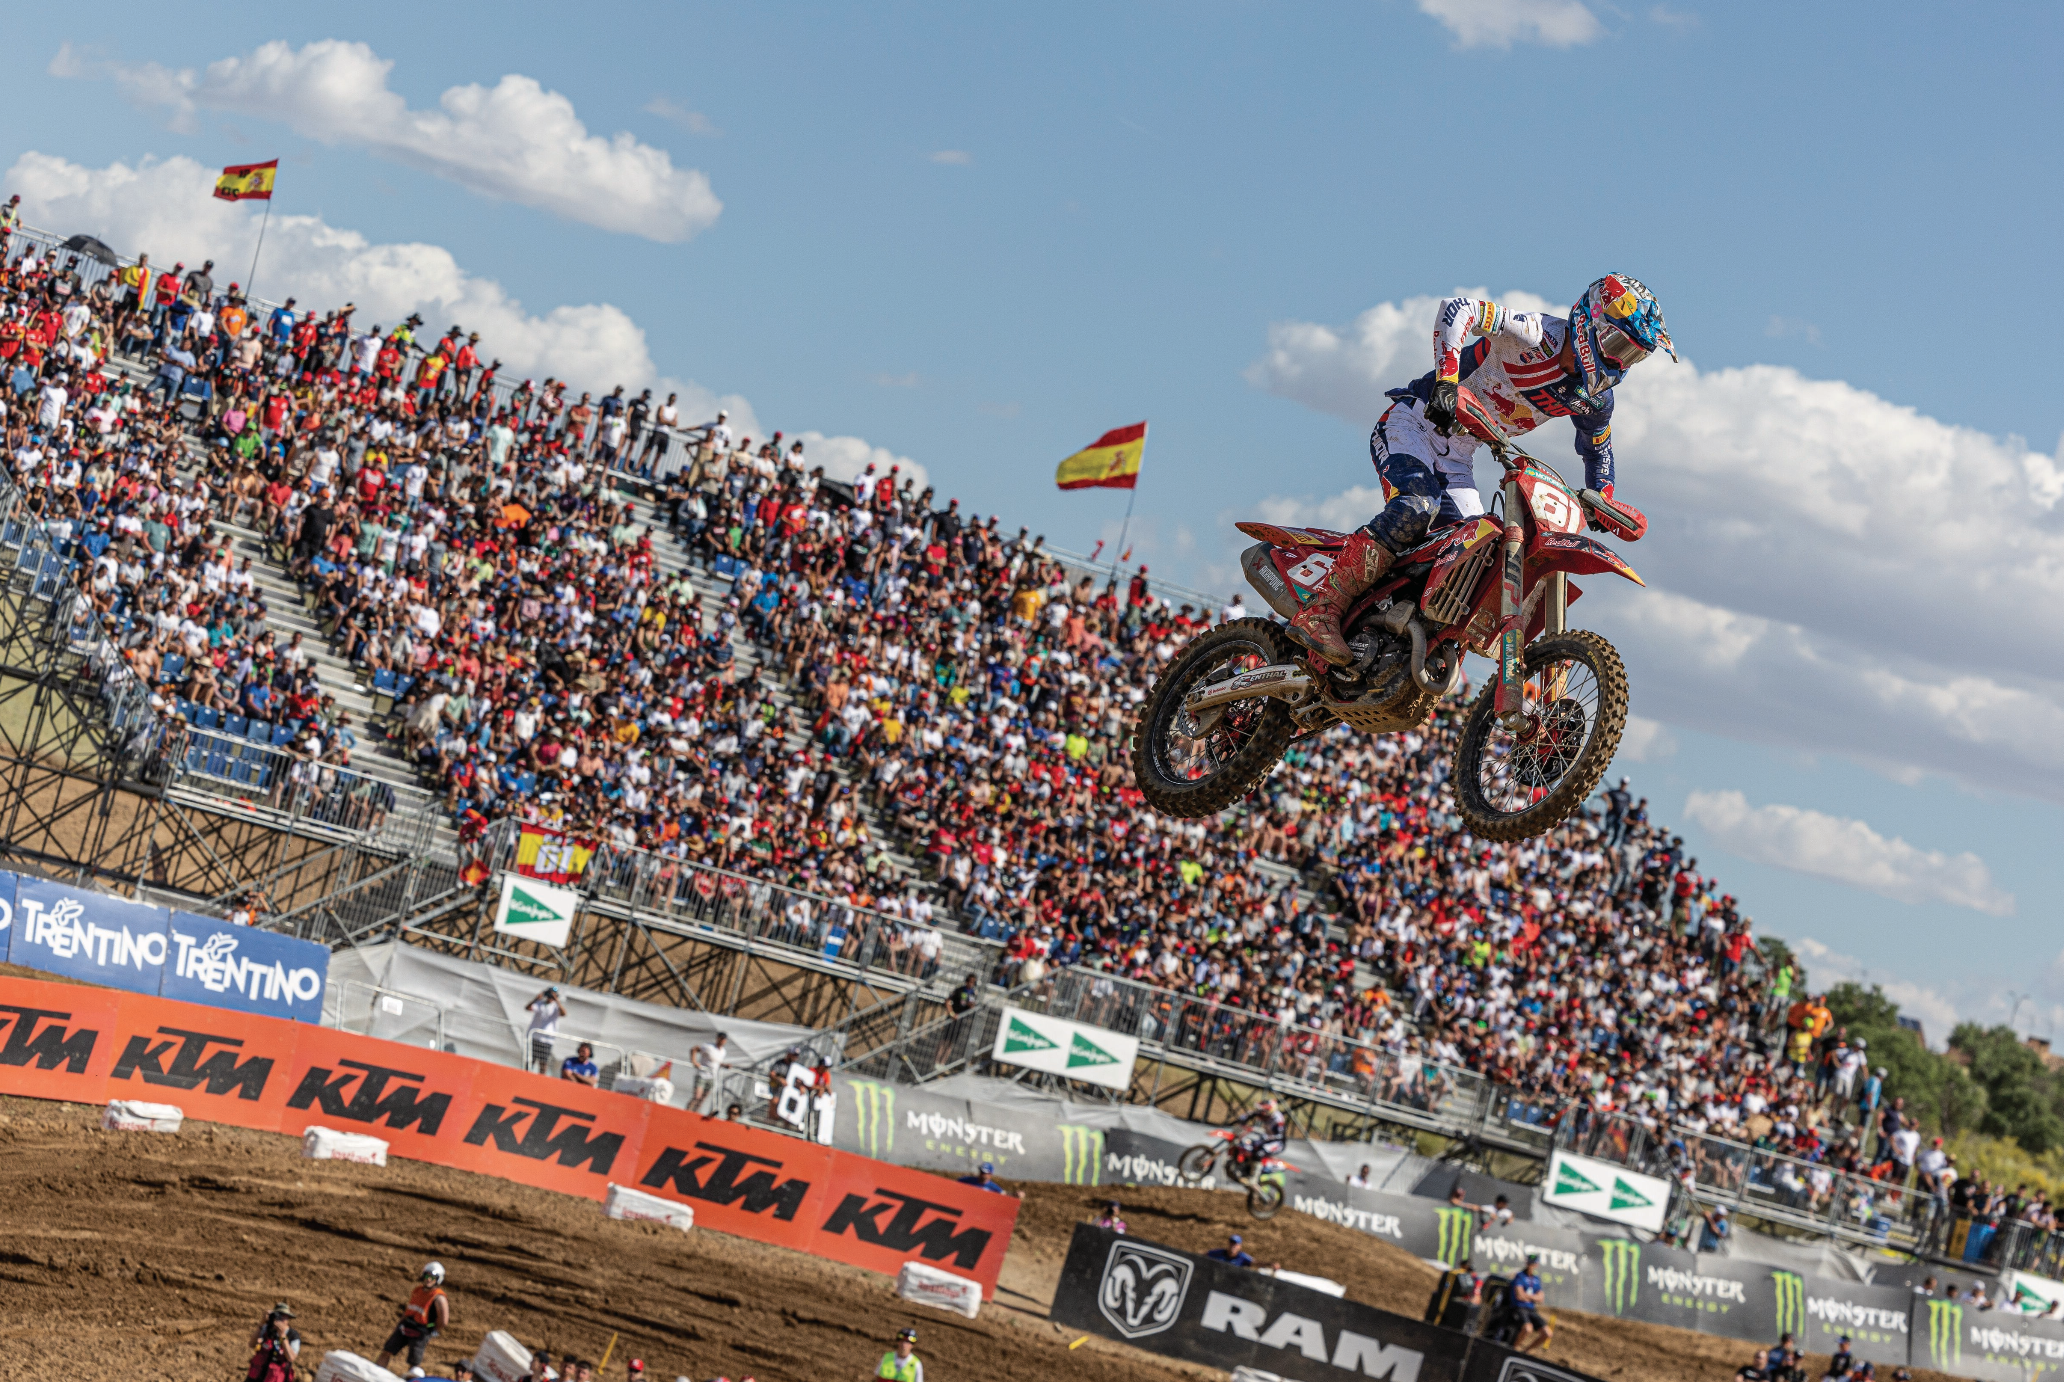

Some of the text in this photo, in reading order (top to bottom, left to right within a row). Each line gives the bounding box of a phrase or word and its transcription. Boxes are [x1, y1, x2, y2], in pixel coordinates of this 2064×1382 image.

[1531, 481, 1581, 535] 61
[21, 898, 167, 970] TRENTINO
[173, 932, 320, 1006] TRENTINO
[0, 1004, 98, 1074] TM
[110, 1026, 274, 1101] KTM
[287, 1059, 453, 1136] KTM
[907, 1109, 1026, 1155] MONSTER
[463, 1097, 626, 1176] KTM
[640, 1141, 811, 1222] KTM
[822, 1188, 993, 1271] KTM
[1647, 1265, 1746, 1304] MONSTER
[1807, 1296, 1908, 1334] MONSTER
[1200, 1290, 1424, 1382] RAM
